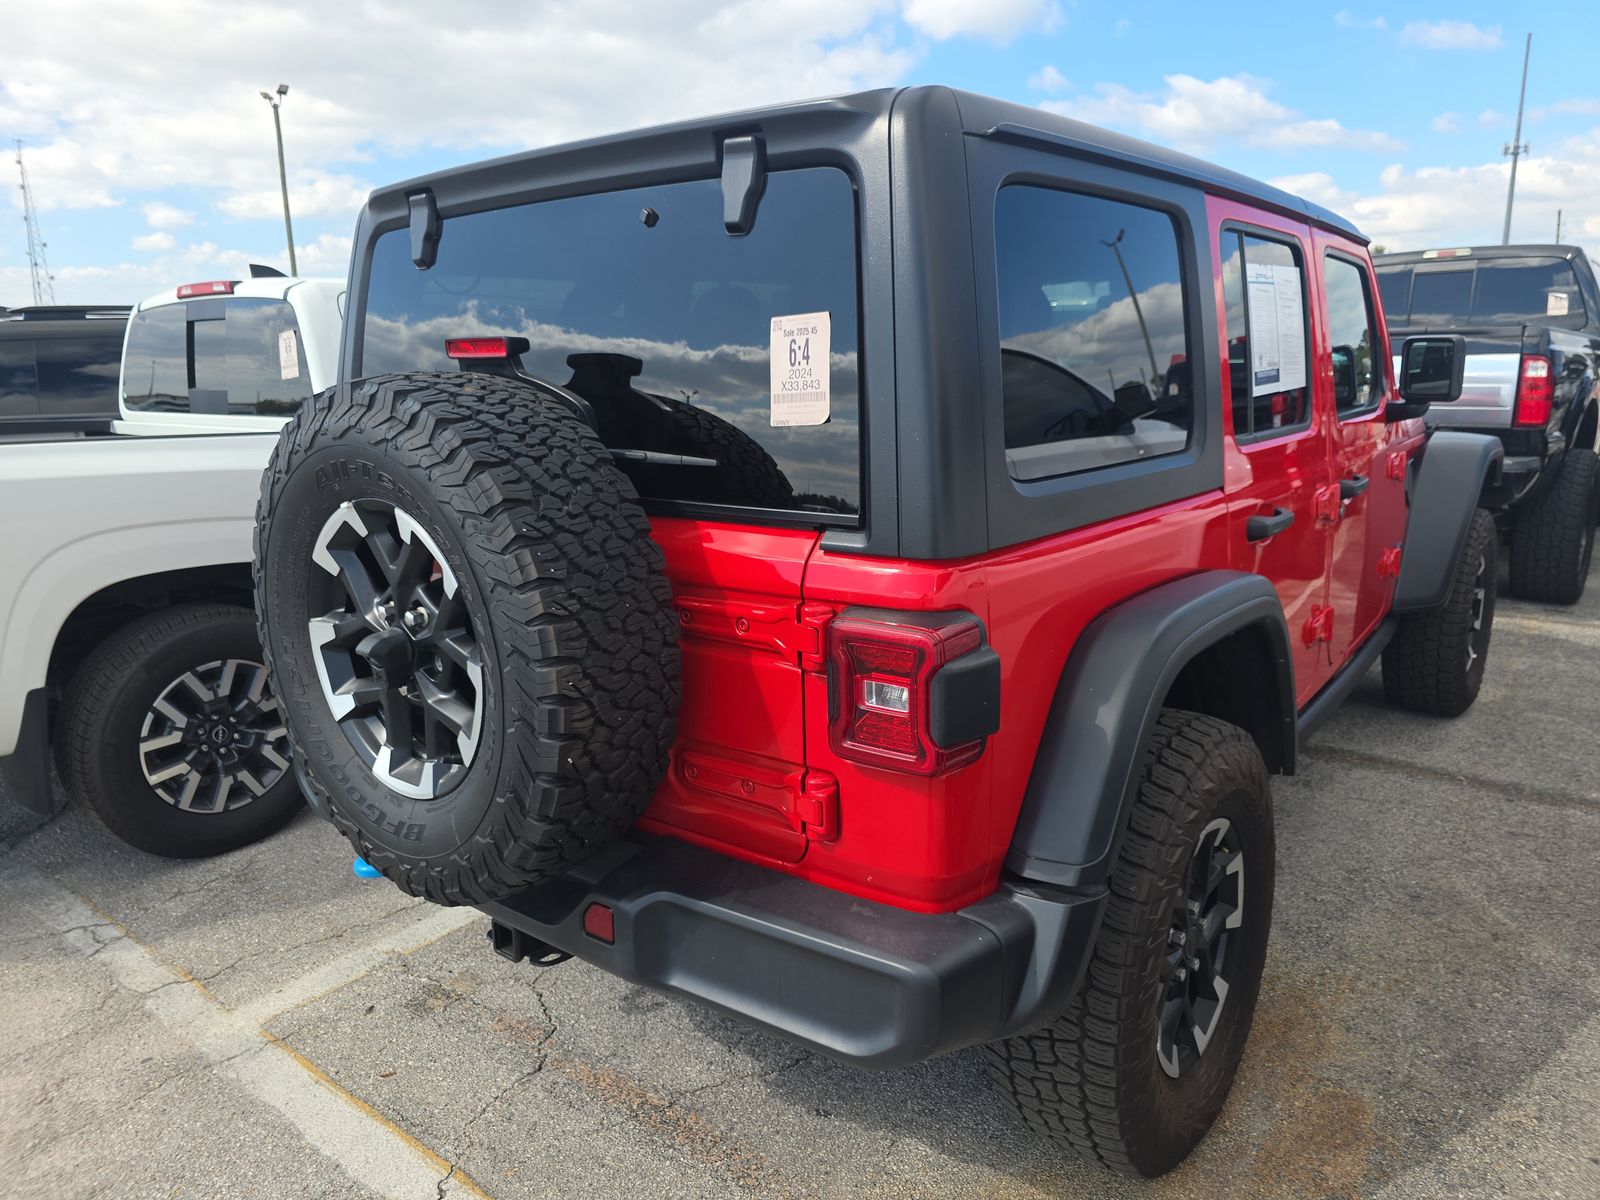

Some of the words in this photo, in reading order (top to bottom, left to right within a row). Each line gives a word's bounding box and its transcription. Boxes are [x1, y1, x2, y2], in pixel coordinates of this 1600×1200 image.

[783, 329, 794, 338] Sale
[796, 327, 810, 337] 2025
[811, 326, 818, 335] 45
[789, 338, 810, 367] 6:4
[788, 368, 812, 380] 2024
